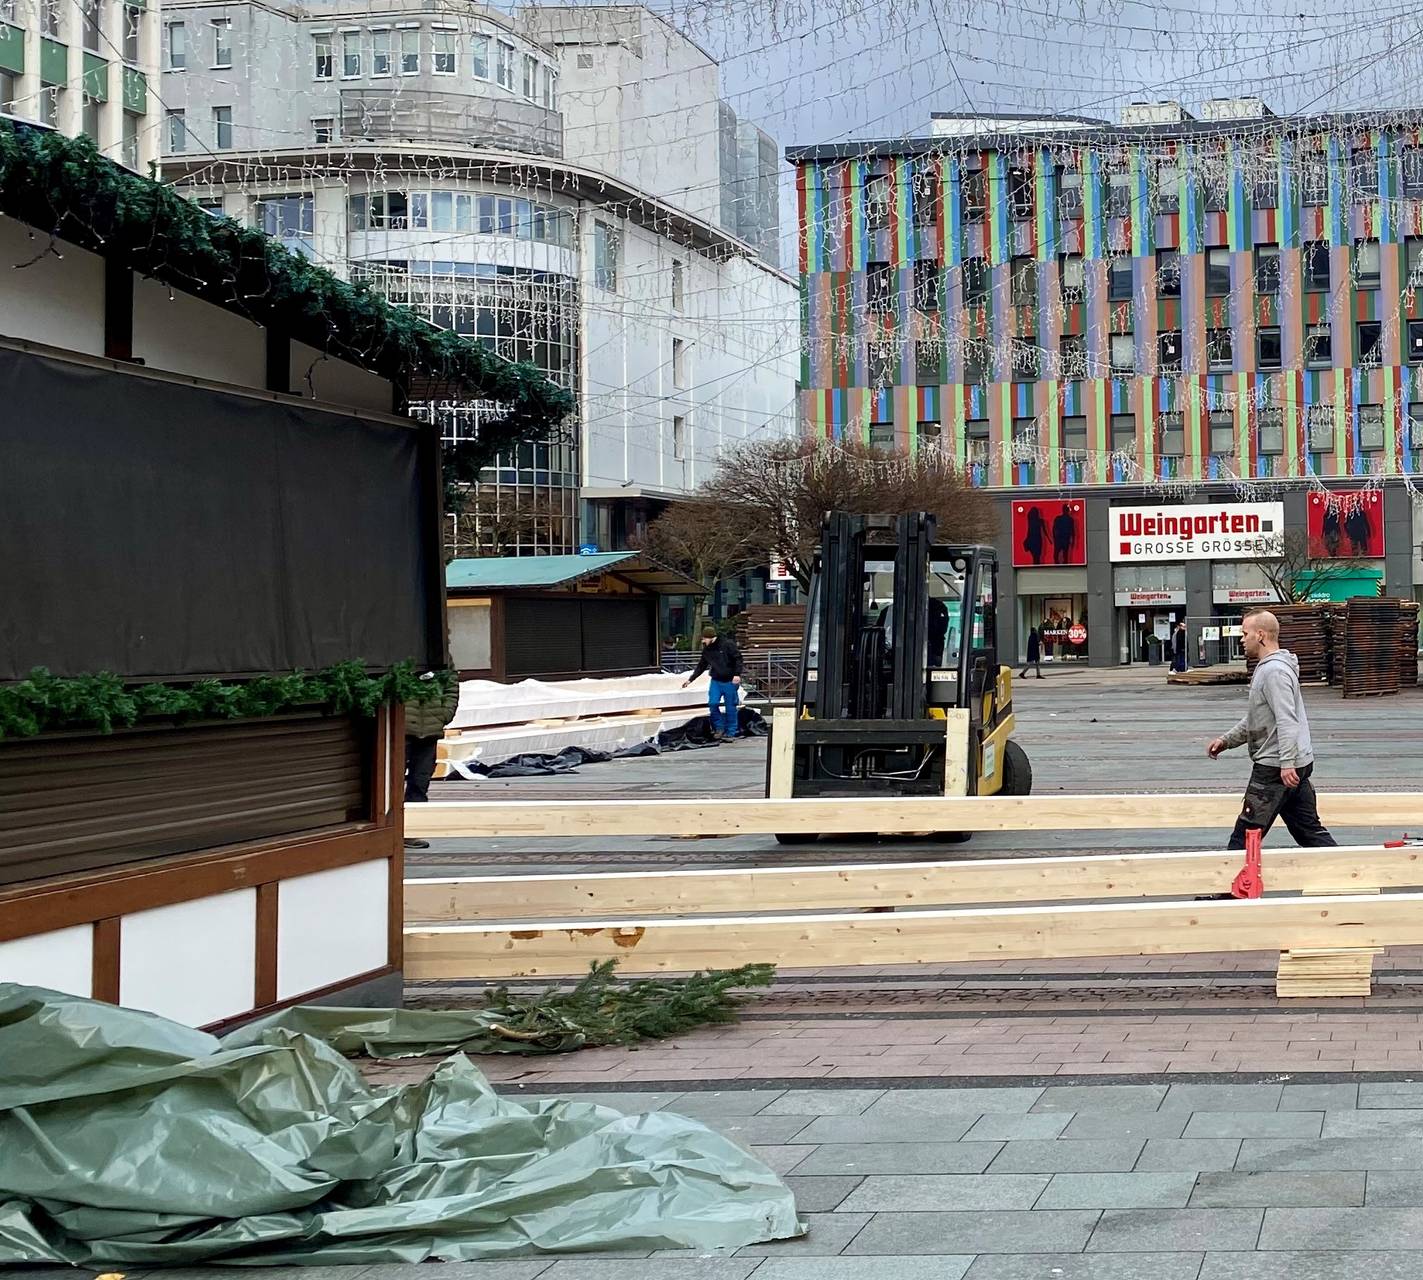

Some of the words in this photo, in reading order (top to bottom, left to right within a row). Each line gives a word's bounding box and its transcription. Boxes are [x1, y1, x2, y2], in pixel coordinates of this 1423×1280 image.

[1119, 512, 1259, 540] Weingarten
[1134, 542, 1194, 554] GROSSE
[1202, 538, 1274, 552] GRÖSSEN
[1131, 593, 1168, 601] Weingarten
[1068, 629, 1086, 638] 30%
